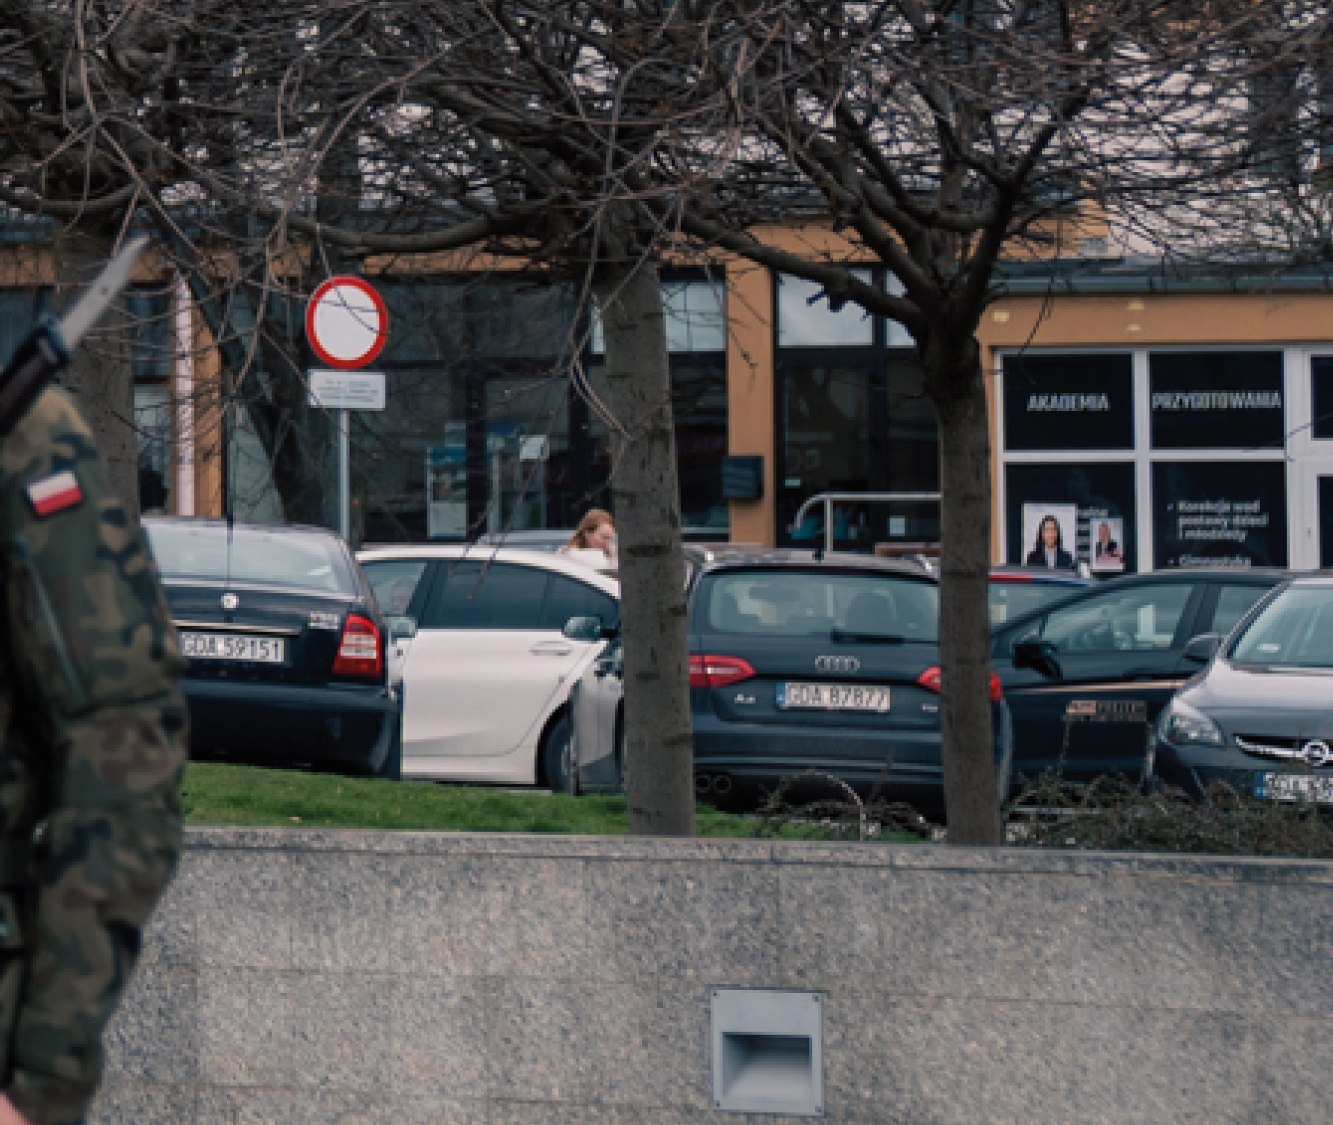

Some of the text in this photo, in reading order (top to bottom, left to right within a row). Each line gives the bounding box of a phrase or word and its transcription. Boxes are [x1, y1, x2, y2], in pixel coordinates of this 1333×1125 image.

[1027, 392, 1110, 412] AKADEMIA
[1151, 390, 1282, 411] PRZYGOTOWANIA
[182, 633, 280, 660] GDA 59151
[787, 683, 889, 709] GDA 87877
